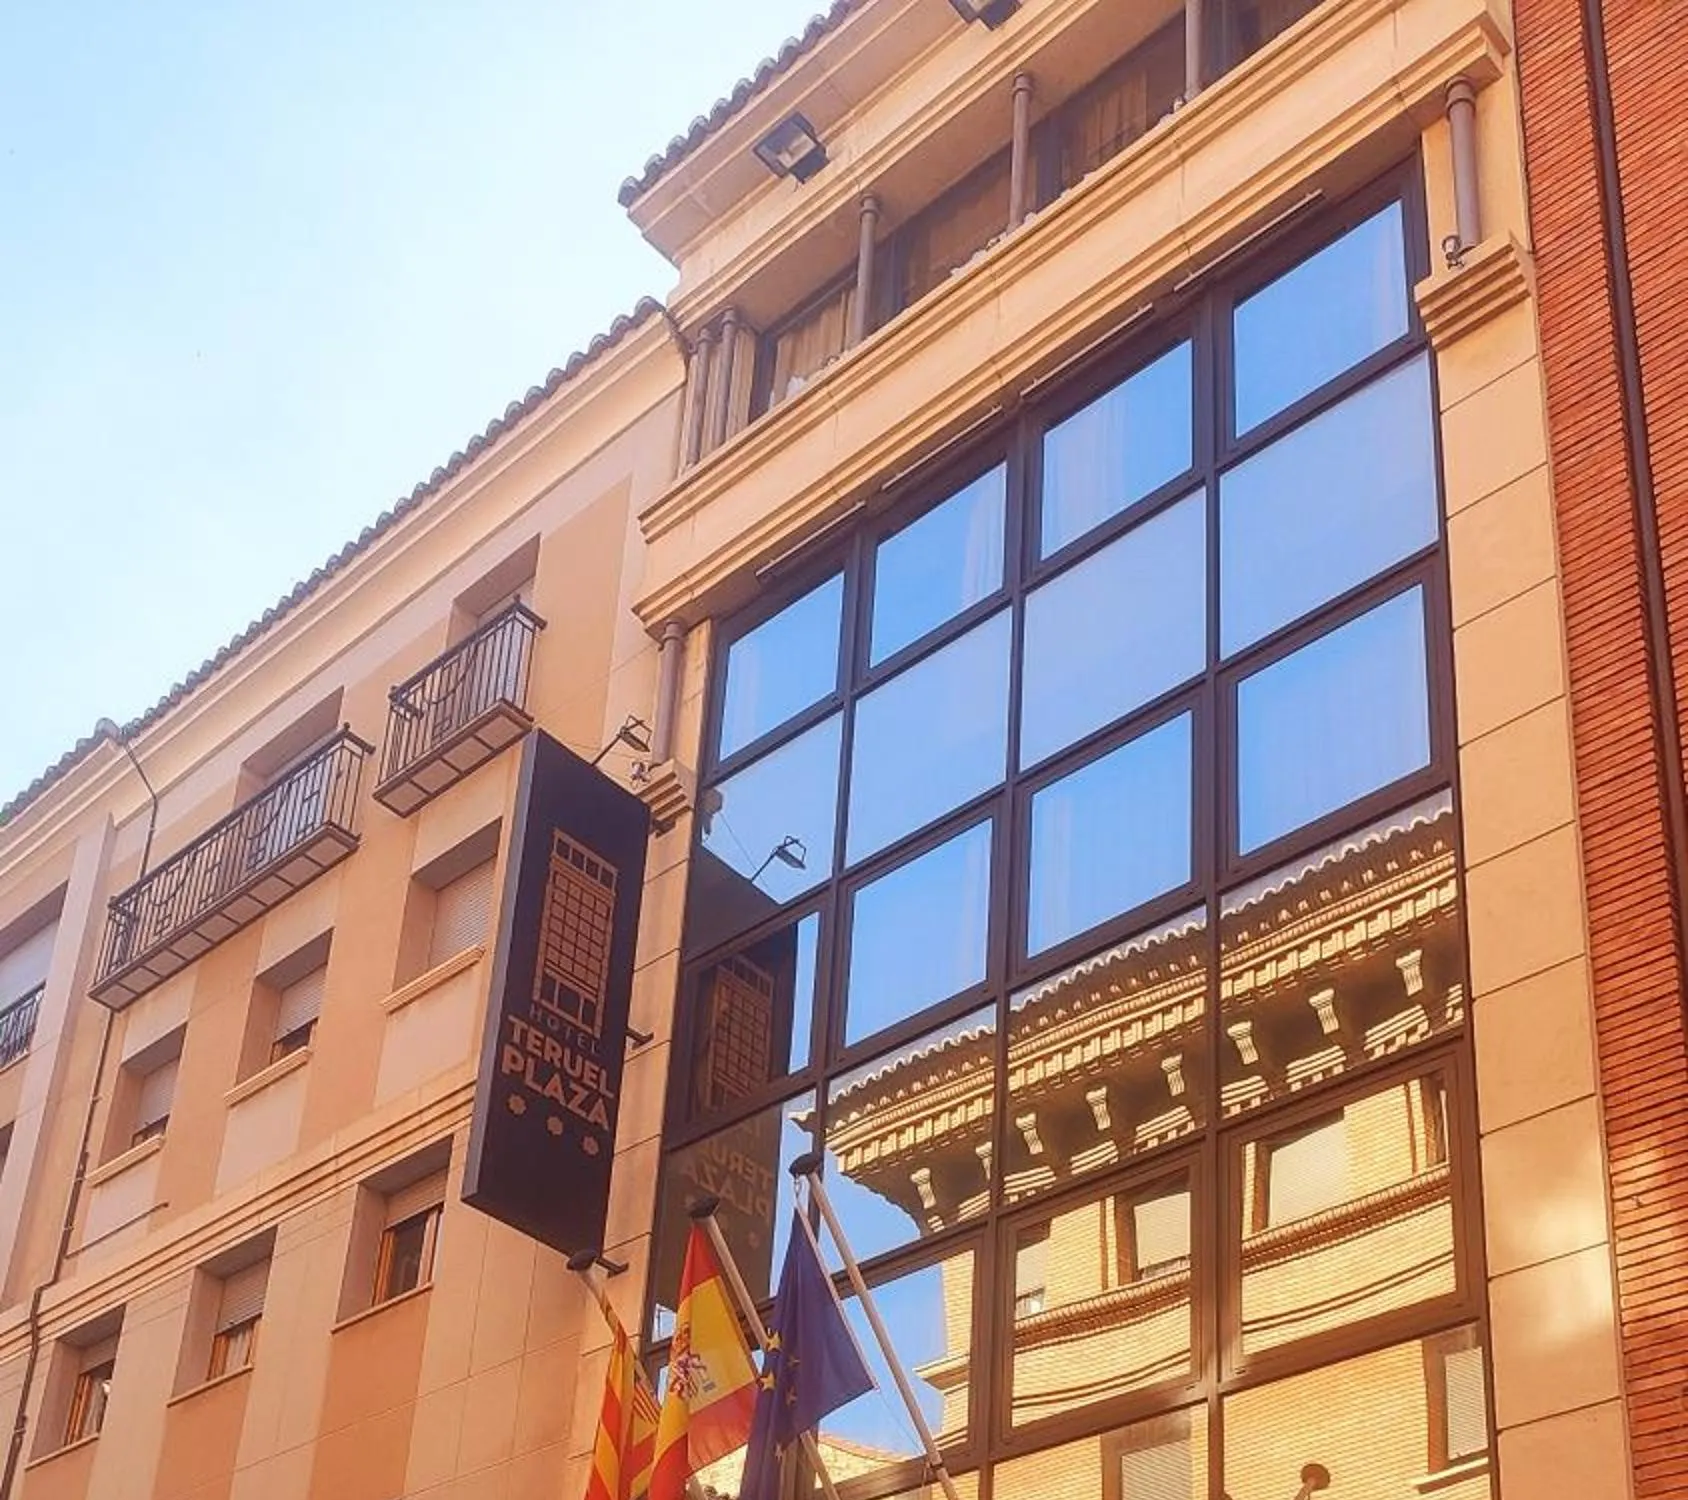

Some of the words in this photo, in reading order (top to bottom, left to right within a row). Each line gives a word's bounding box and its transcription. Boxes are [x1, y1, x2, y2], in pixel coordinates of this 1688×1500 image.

[507, 1014, 615, 1099] TERUEL
[529, 1002, 601, 1056] HOTEL
[501, 1043, 609, 1131] PLAZA
